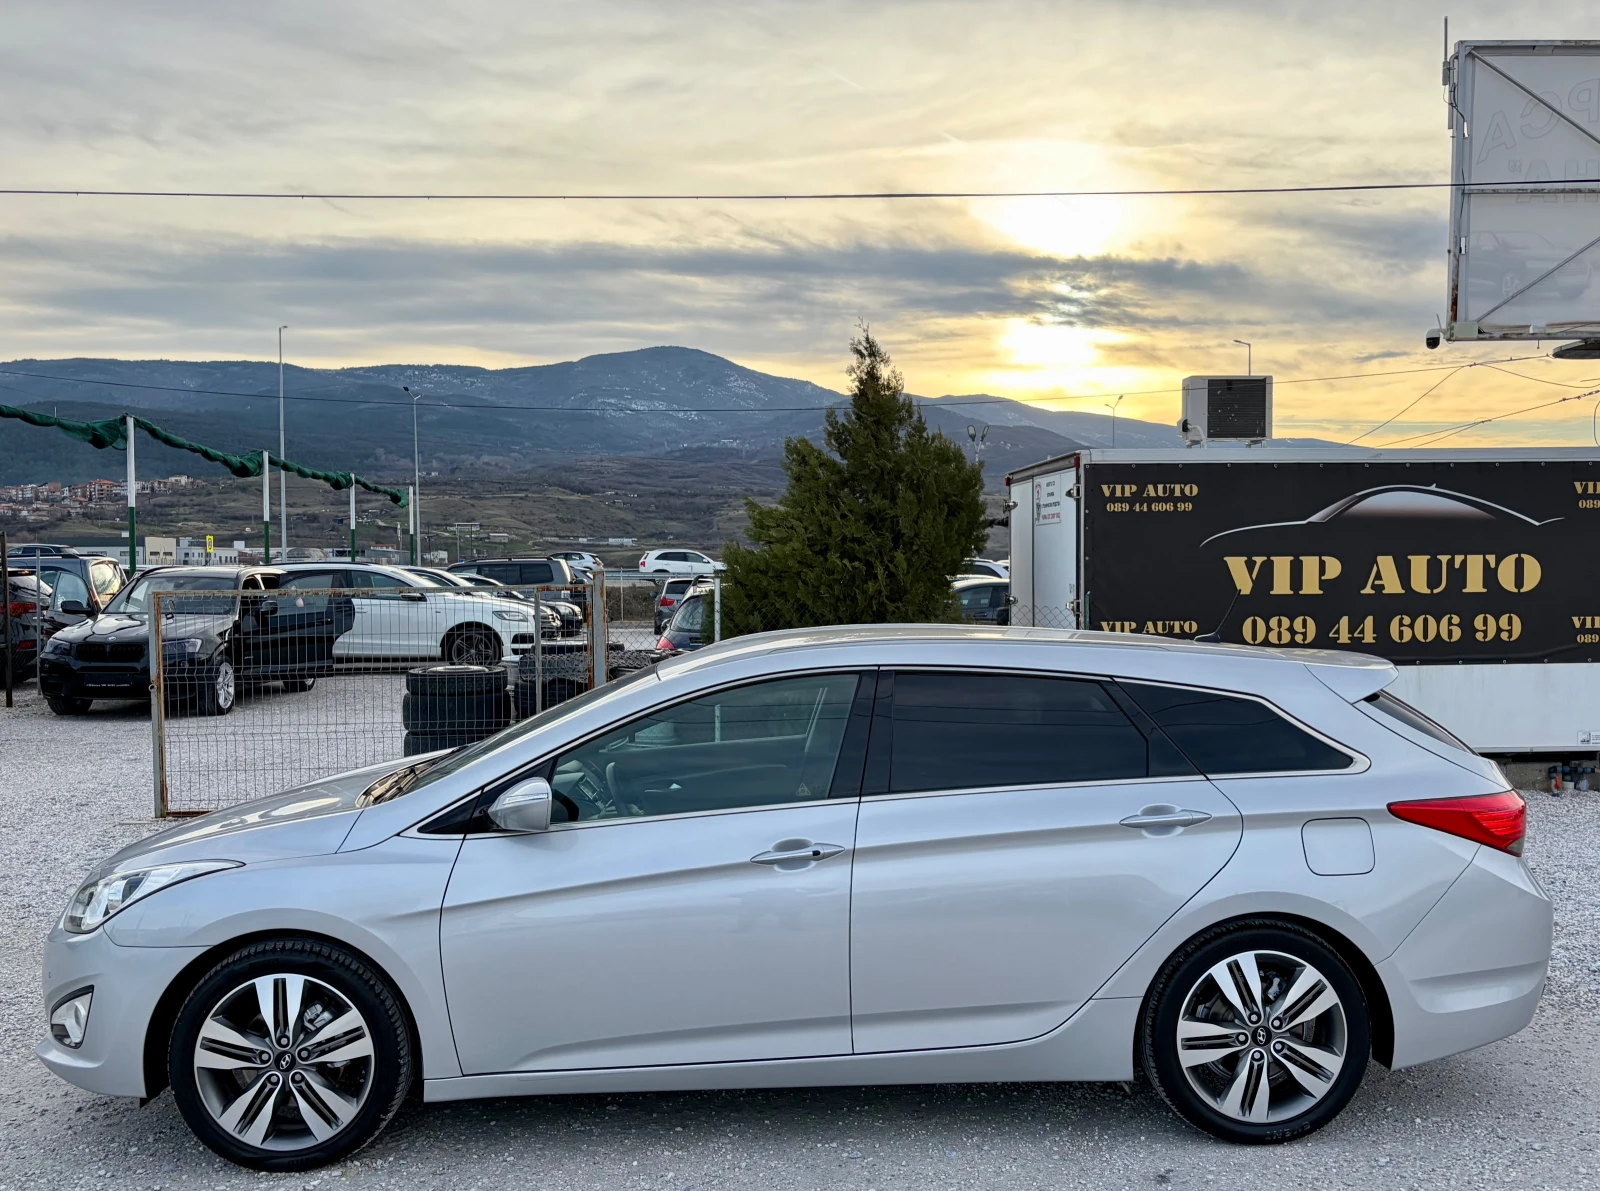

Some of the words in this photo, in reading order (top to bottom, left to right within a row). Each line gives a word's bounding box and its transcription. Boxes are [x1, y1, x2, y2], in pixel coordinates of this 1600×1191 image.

[1100, 484, 1138, 497] VIP
[1142, 483, 1199, 497] AUTO
[1106, 502, 1130, 512] 089
[1133, 502, 1148, 512] 44
[1151, 502, 1174, 512] 606
[1177, 502, 1193, 512] 99
[1578, 499, 1600, 509] 089
[1223, 555, 1343, 595] VIP
[1360, 553, 1542, 594] AUTO
[1100, 621, 1137, 633] VIP
[1142, 620, 1198, 634] AUTO
[1242, 616, 1317, 644] 089
[1328, 615, 1377, 643] 44
[1389, 614, 1462, 643] 606
[1473, 613, 1522, 642] 99
[1576, 633, 1600, 643] 089
